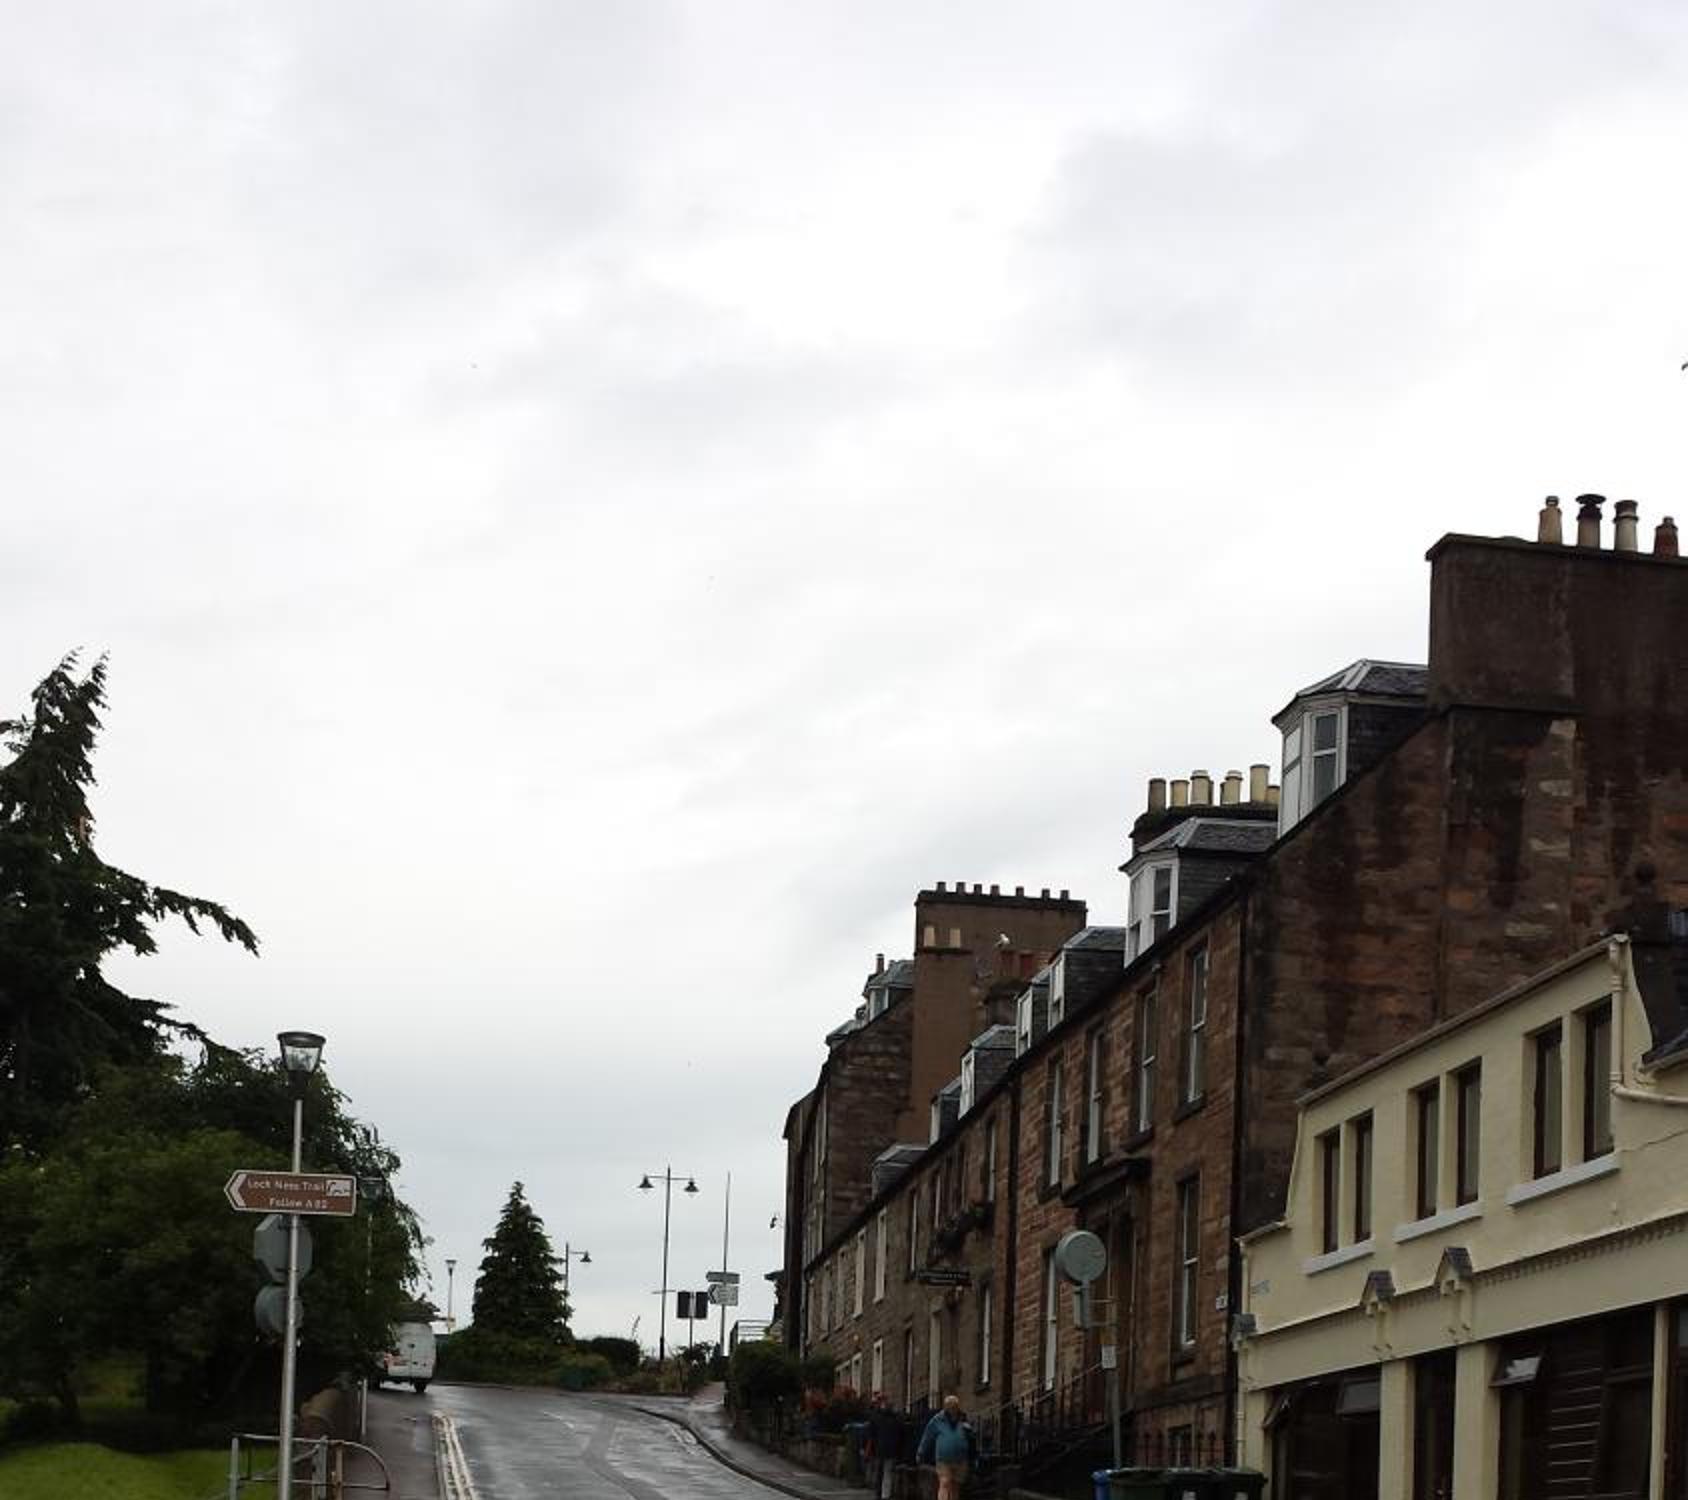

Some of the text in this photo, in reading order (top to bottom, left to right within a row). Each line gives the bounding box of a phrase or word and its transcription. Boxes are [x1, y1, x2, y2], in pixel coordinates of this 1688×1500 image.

[275, 1179, 299, 1191] Ness
[303, 1181, 324, 1191] Trail
[269, 1198, 302, 1208] Follow
